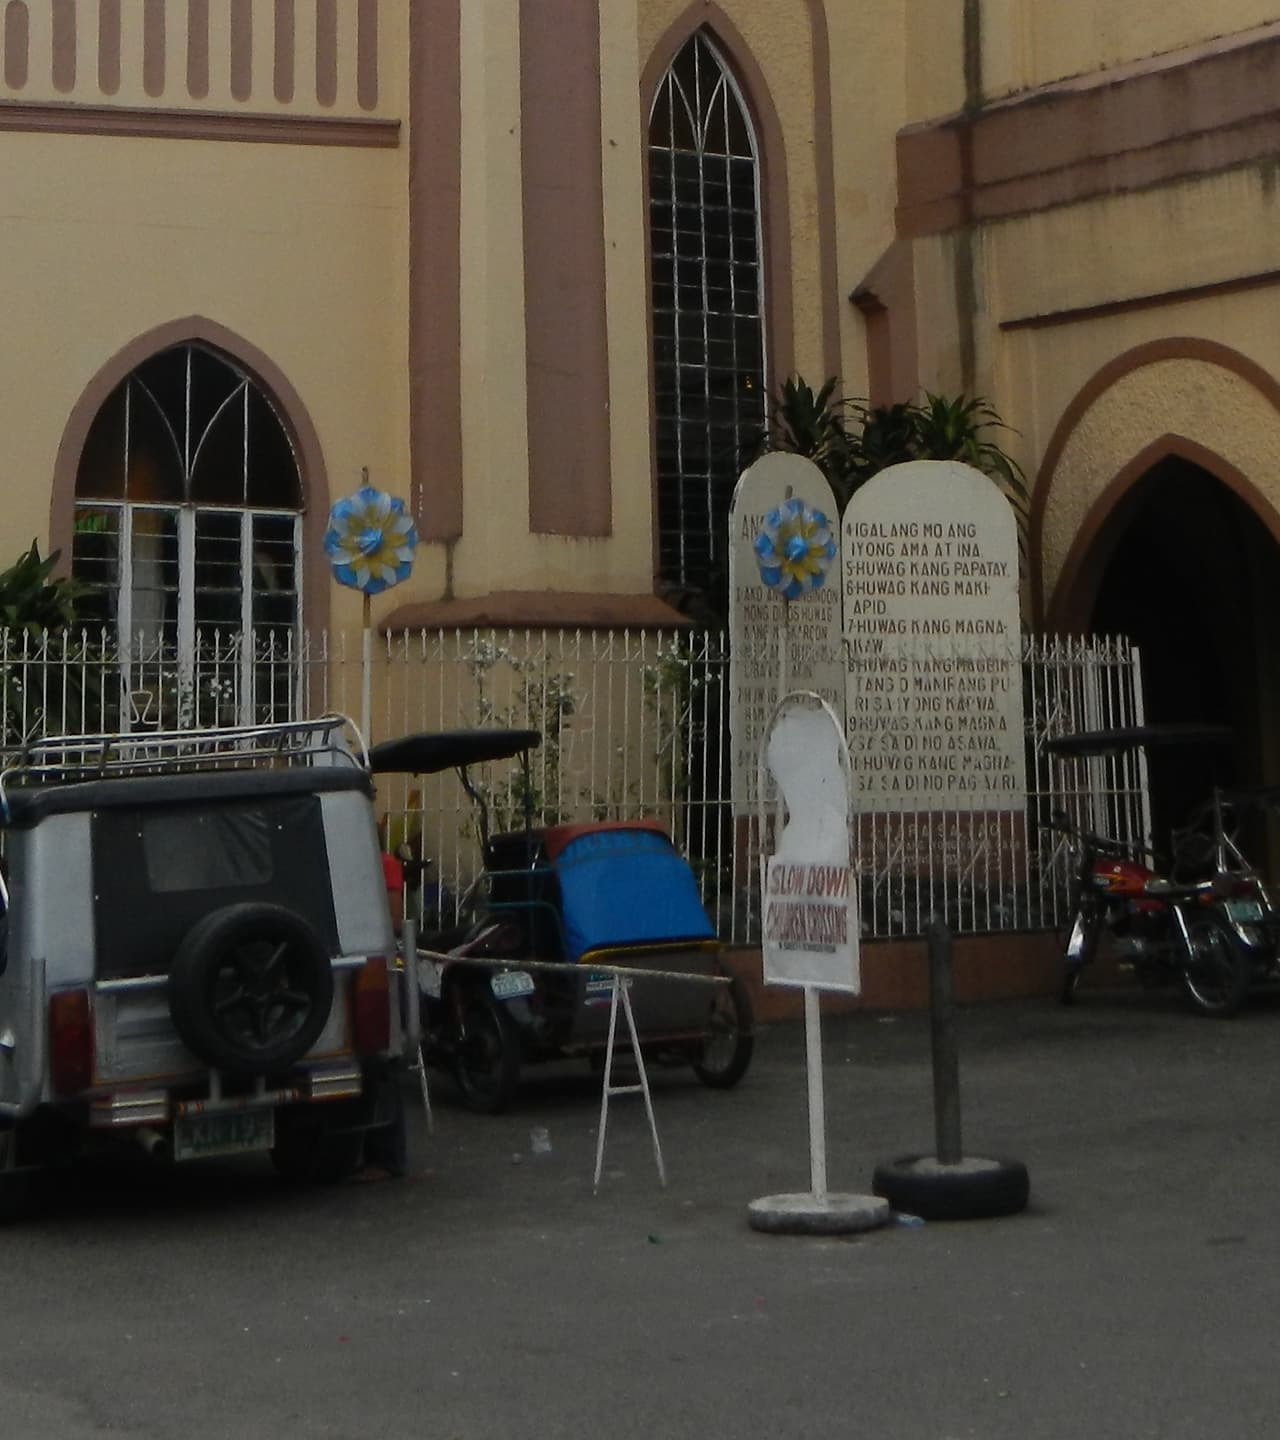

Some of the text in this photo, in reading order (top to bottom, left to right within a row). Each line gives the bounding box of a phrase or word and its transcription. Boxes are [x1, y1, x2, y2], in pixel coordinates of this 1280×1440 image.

[923, 522, 942, 538] MO
[948, 522, 977, 538] ANG
[851, 542, 895, 557] IYONG
[900, 542, 929, 557] AMA
[934, 542, 952, 557] AT
[911, 561, 950, 577] KANG
[954, 561, 1010, 578] PAPATAY.
[911, 580, 950, 596] KANG
[911, 619, 951, 635] KANG
[913, 658, 952, 673] KANG
[856, 677, 894, 692] TANG
[915, 716, 954, 731] KANG
[918, 755, 957, 771] KANG
[770, 864, 849, 897] SLOW DOWN
